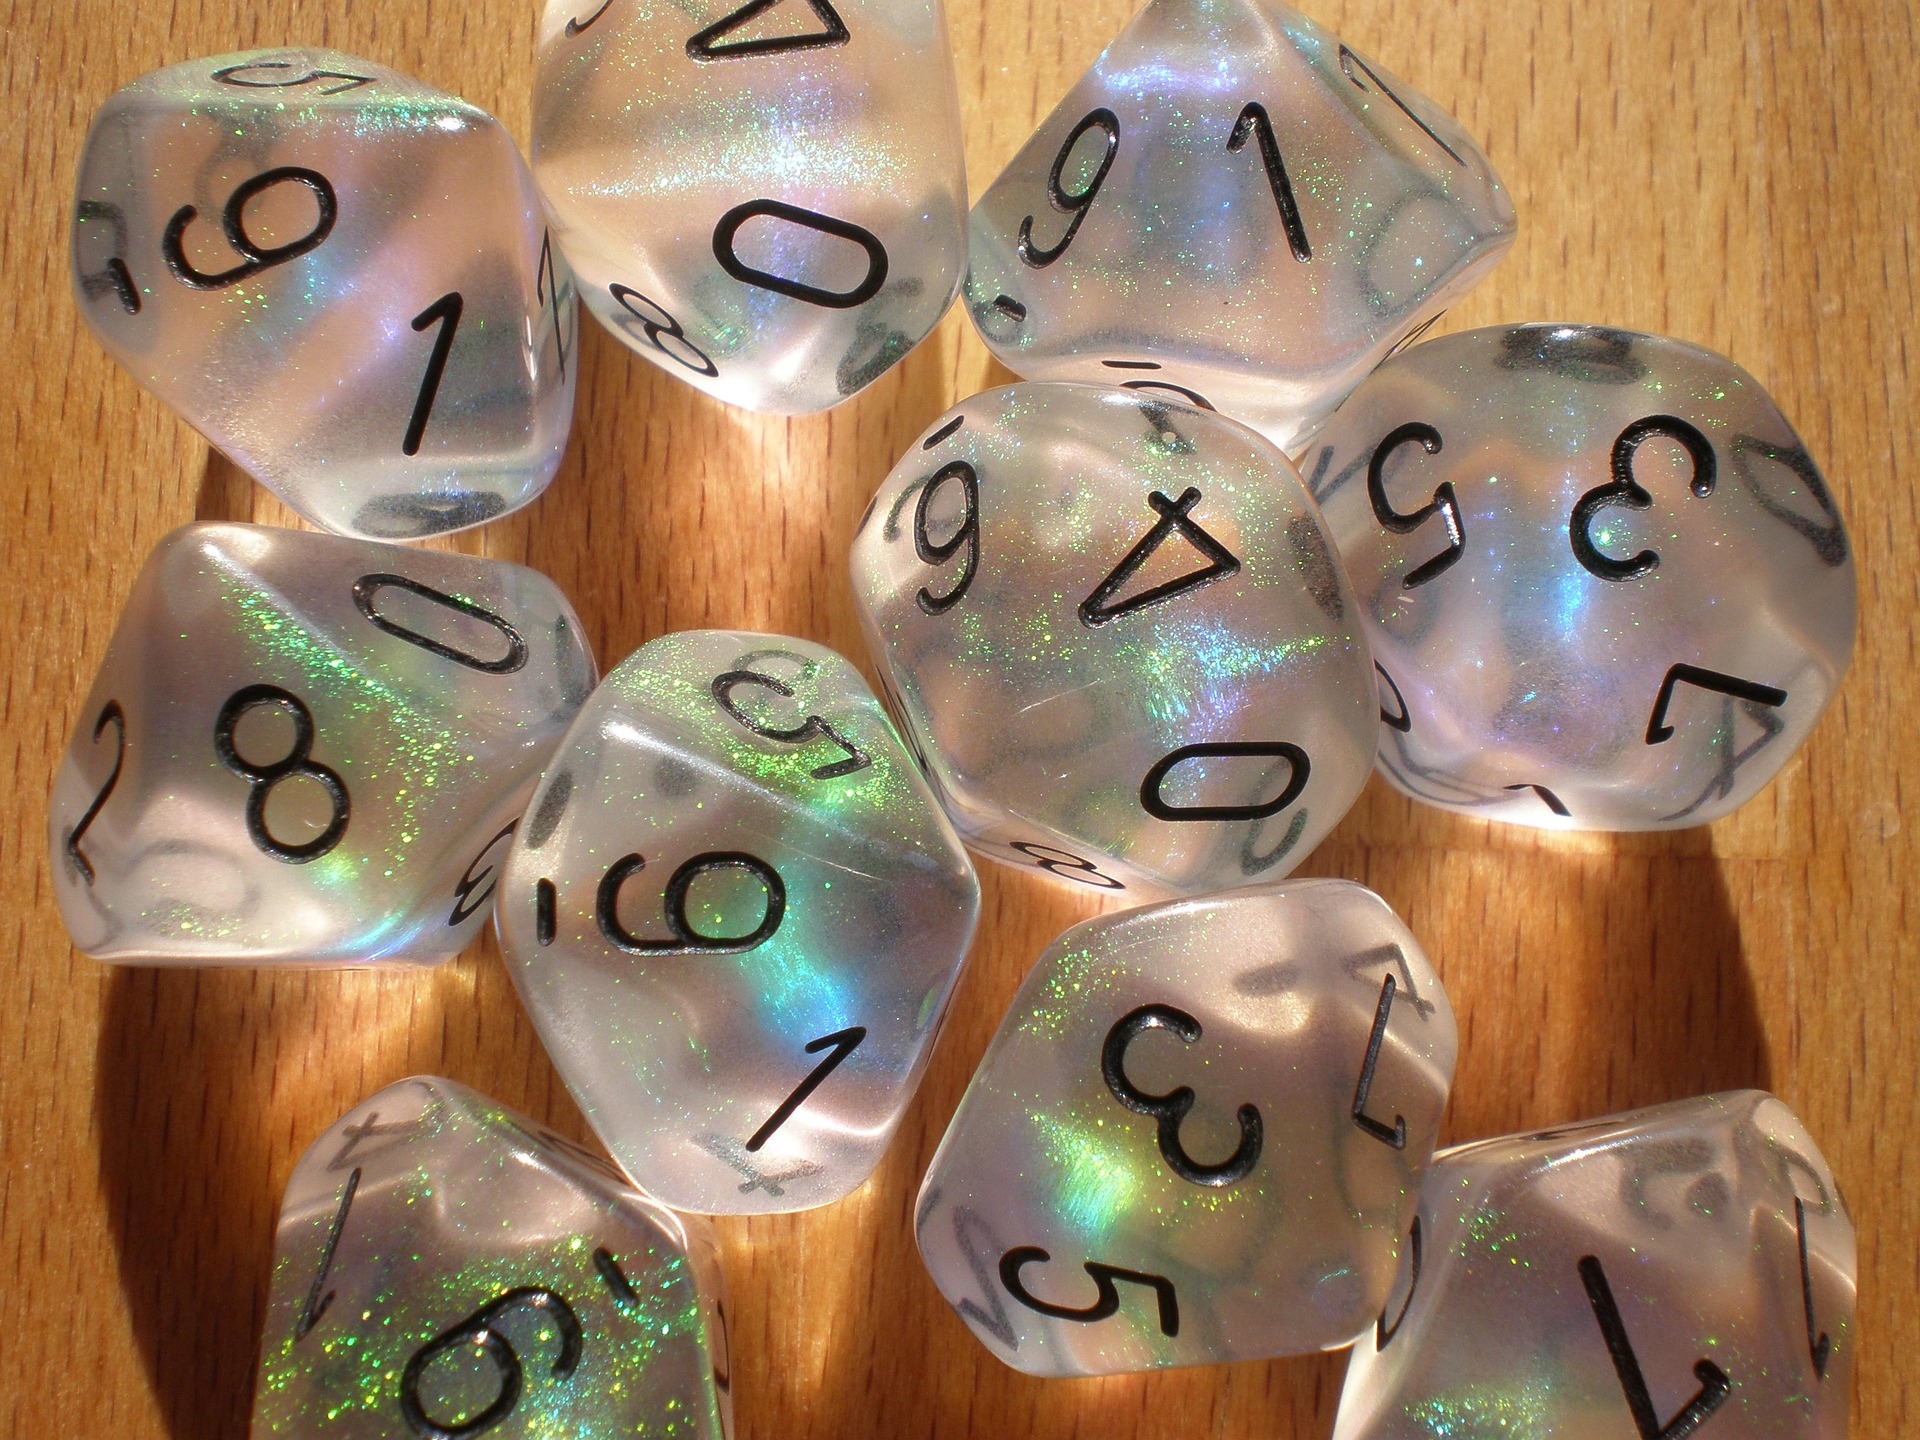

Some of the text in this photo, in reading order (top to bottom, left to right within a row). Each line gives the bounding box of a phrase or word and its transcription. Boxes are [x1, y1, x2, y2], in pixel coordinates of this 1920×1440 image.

[210, 62, 376, 96] 5
[1226, 101, 1312, 263] 1
[712, 198, 889, 309] 0
[403, 291, 464, 457] 1
[609, 282, 719, 378] 8
[1078, 486, 1241, 630] 4
[1367, 422, 1466, 590] 5
[1569, 414, 1717, 582] 3
[352, 573, 529, 675] 0
[711, 669, 872, 780] 5
[1645, 663, 1788, 745] 7
[66, 699, 126, 887] 2
[214, 683, 352, 865] 8
[1140, 742, 1311, 822] 0
[1010, 842, 1126, 890] 8
[744, 1026, 866, 1152] 1
[1101, 1003, 1263, 1188] 3
[1352, 972, 1406, 1150] 7
[999, 1246, 1179, 1338] 5
